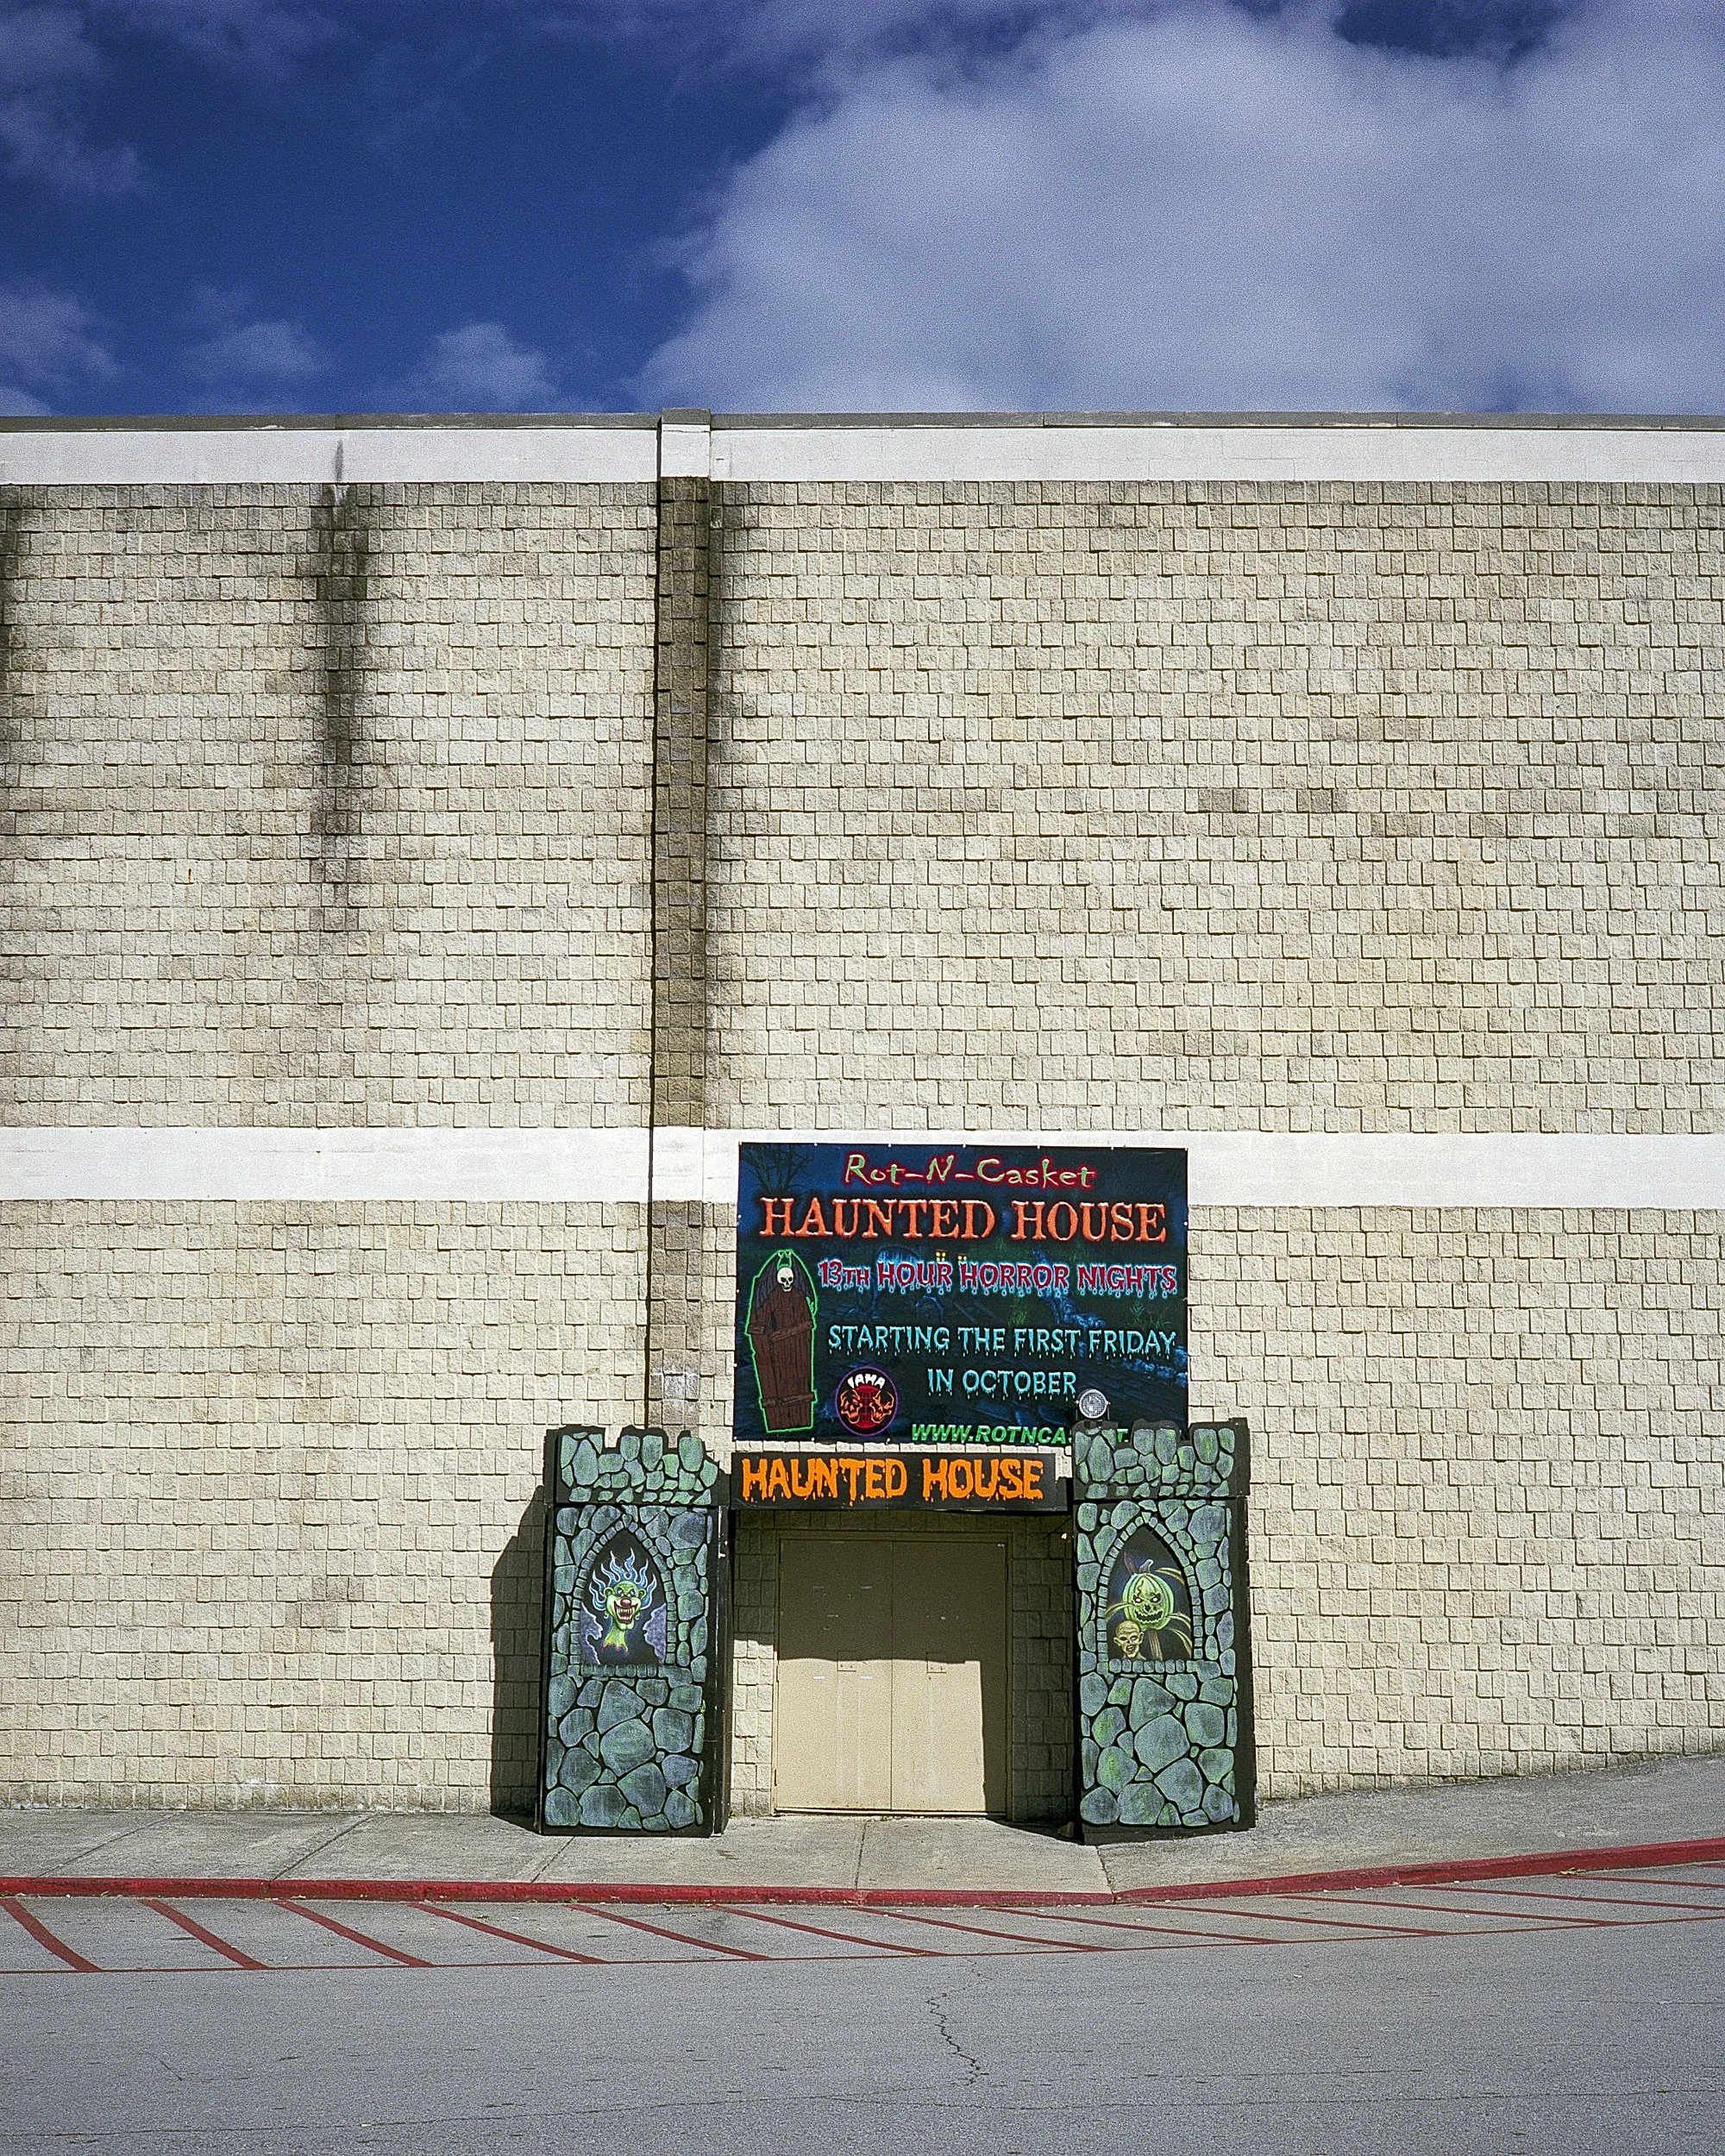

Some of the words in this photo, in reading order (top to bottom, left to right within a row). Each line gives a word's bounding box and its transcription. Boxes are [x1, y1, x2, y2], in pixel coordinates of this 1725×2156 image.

[844, 1153, 1097, 1188] Rot-N-Casket
[759, 1196, 995, 1239] HAUNTED
[1011, 1200, 1167, 1242] HOUSE
[876, 1260, 952, 1293] HOUR
[958, 1261, 1070, 1296] HORROR
[1077, 1263, 1177, 1298] NIGHTS
[828, 1325, 950, 1356] STARTING
[957, 1327, 1006, 1357] THE
[1014, 1328, 1082, 1358] FIRST
[1088, 1330, 1176, 1360] FRIDAY
[847, 1373, 886, 1389] IAHA
[927, 1369, 953, 1396] IN
[963, 1369, 1076, 1401] OCTOBER
[742, 1457, 907, 1507] HAUNTED
[922, 1457, 1044, 1503] HOUSE
